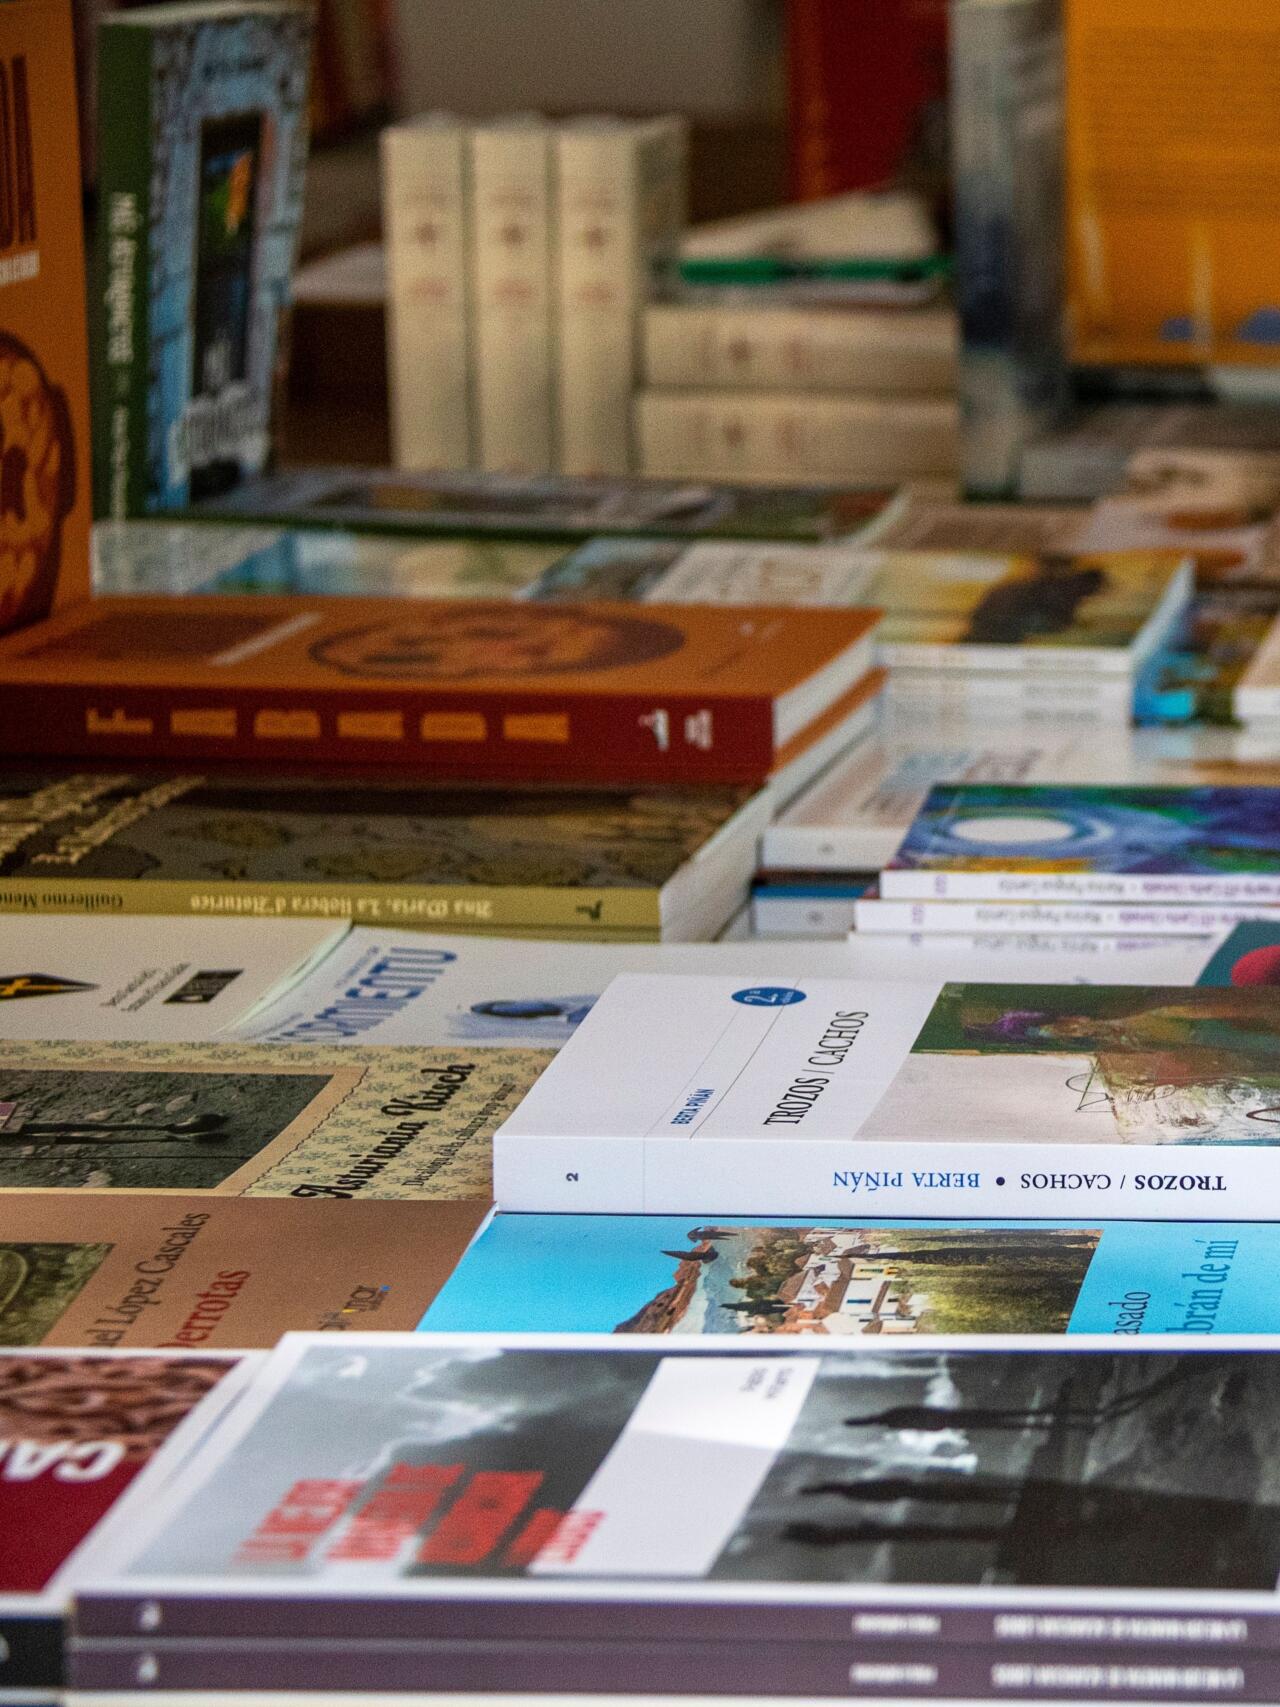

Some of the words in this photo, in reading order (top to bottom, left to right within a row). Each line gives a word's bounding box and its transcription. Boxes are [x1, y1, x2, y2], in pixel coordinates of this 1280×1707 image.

[41, 892, 123, 909] Guillermo
[763, 1076, 830, 1126] TROZOS
[807, 1010, 869, 1066] CACHOS
[670, 1106, 700, 1126] BERTA
[688, 1087, 715, 1108] PIÑÁN
[291, 1121, 429, 1198] Asturiania
[381, 1063, 475, 1117] Kitsch
[566, 1171, 580, 1184] 2
[833, 1171, 903, 1192] PIÑÁN
[913, 1172, 980, 1188] BERTA
[1019, 1173, 1112, 1190] CACHOS
[1134, 1174, 1227, 1191] TROZOS
[135, 1213, 211, 1274] Cascales
[1194, 1239, 1239, 1260] mí
[1182, 1263, 1231, 1284] de
[0, 1439, 127, 1483] CA
